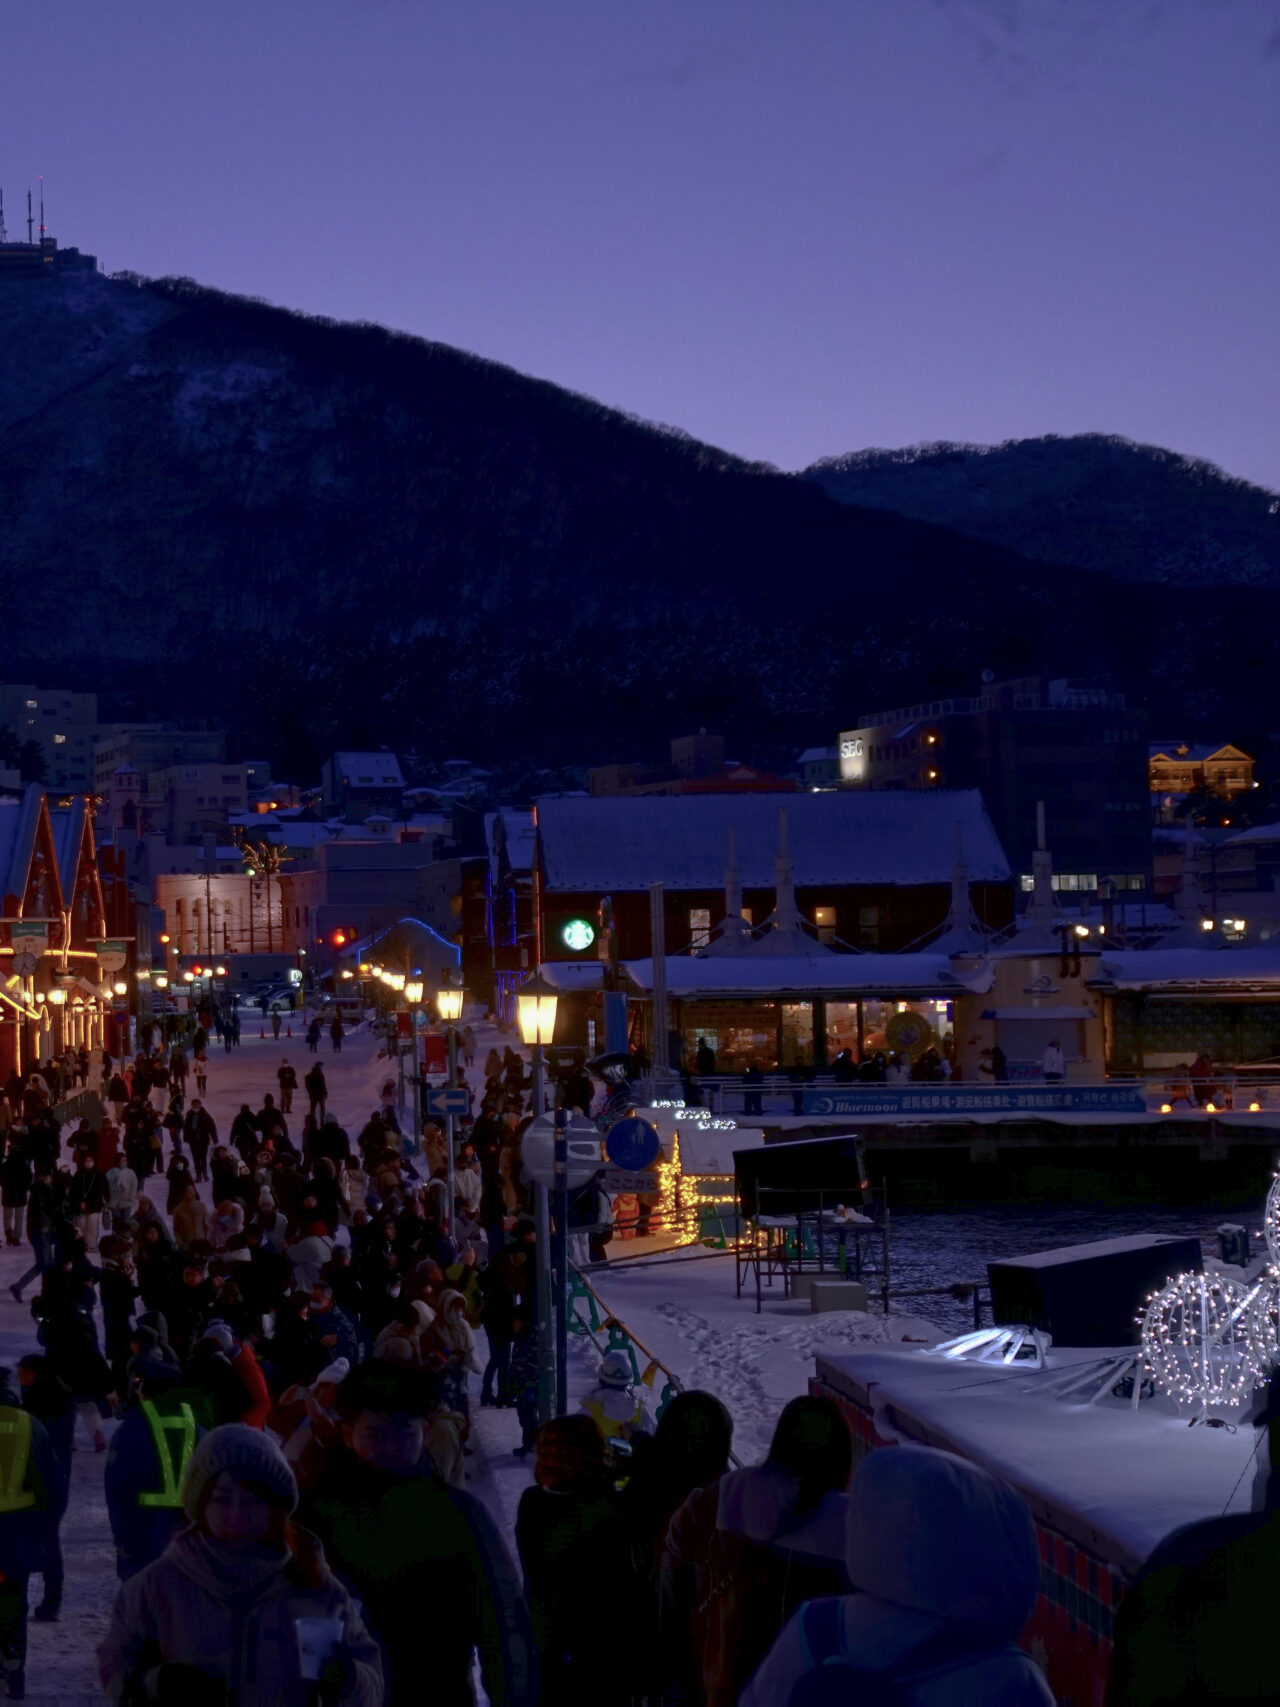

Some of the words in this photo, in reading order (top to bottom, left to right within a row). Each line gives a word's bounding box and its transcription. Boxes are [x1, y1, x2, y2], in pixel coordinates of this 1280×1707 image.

[835, 1102, 899, 1112] Bluemoon
[610, 1178, 658, 1190] ここから
